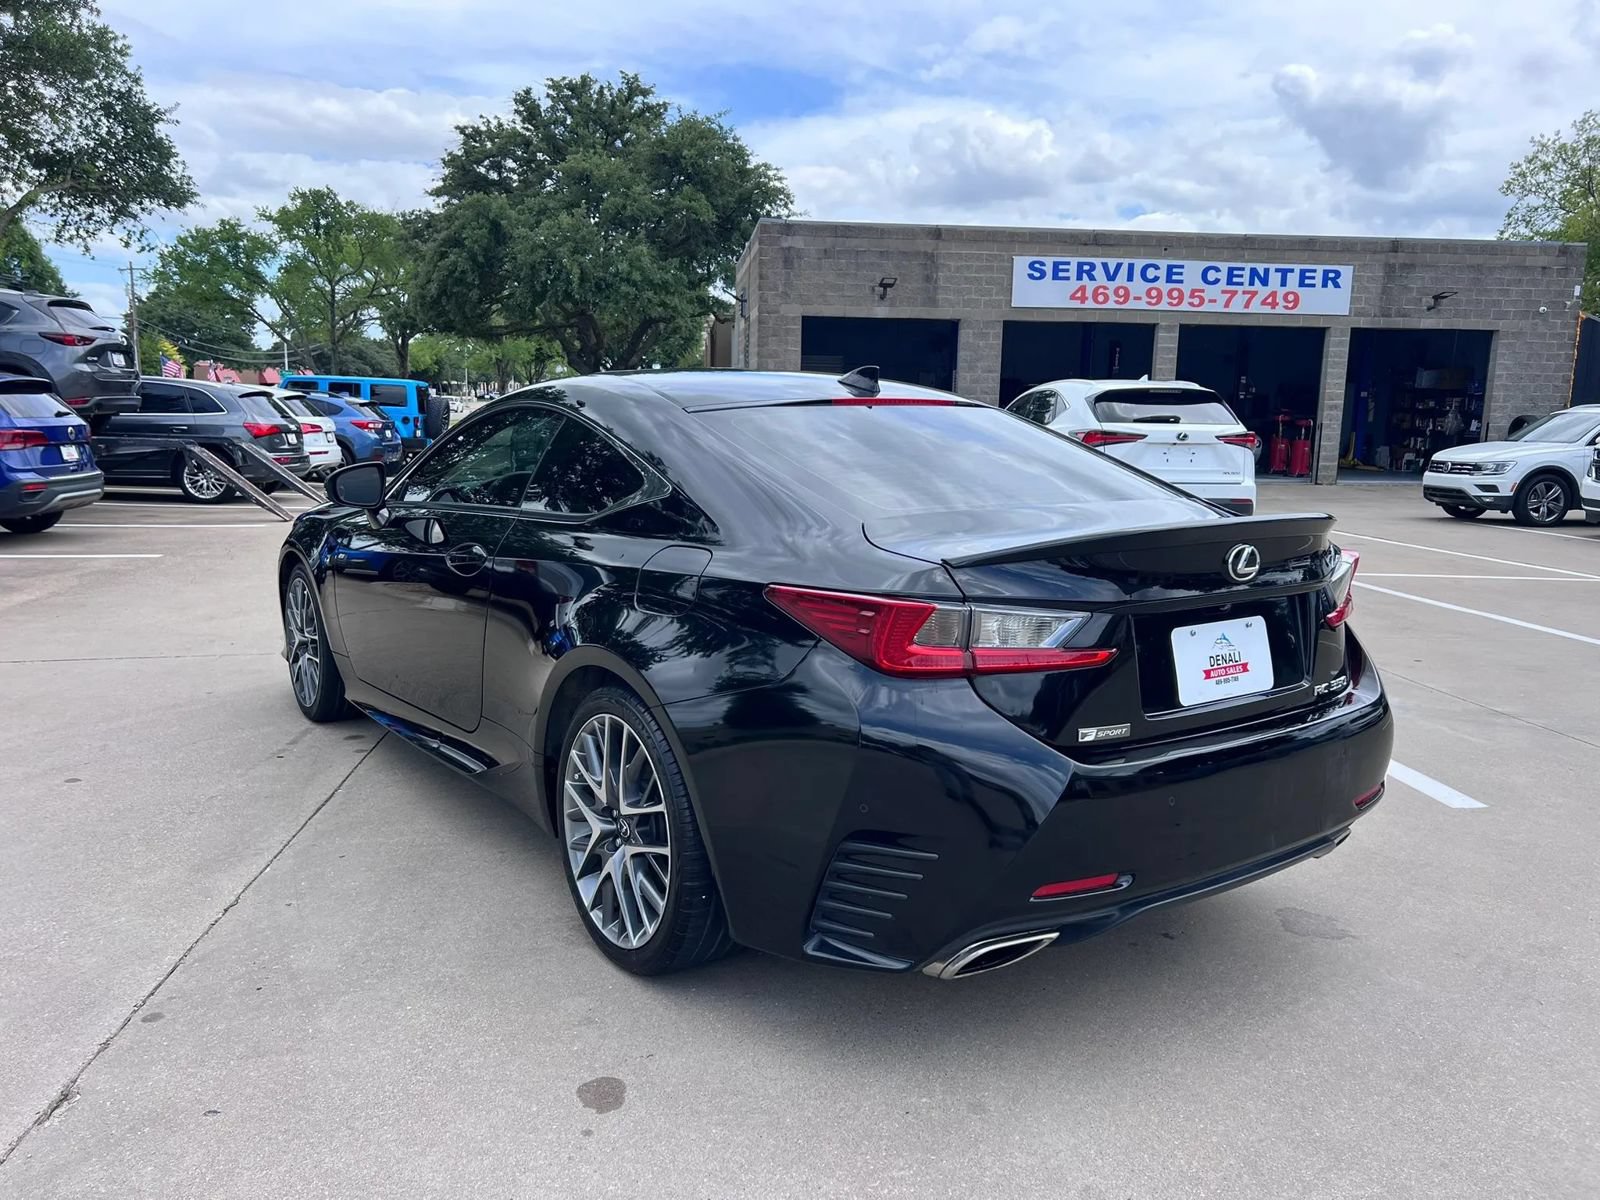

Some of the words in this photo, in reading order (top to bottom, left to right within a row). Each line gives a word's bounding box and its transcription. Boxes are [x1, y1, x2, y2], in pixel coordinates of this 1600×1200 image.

[1027, 260, 1185, 284] SERVICE
[1201, 265, 1342, 289] CENTER
[1069, 284, 1300, 310] 469-995-7749
[1209, 651, 1242, 667] DENALI
[1210, 668, 1226, 678] AUTO
[1226, 665, 1243, 675] SALES
[1314, 682, 1329, 696] RC
[1097, 728, 1127, 738] SPORT
